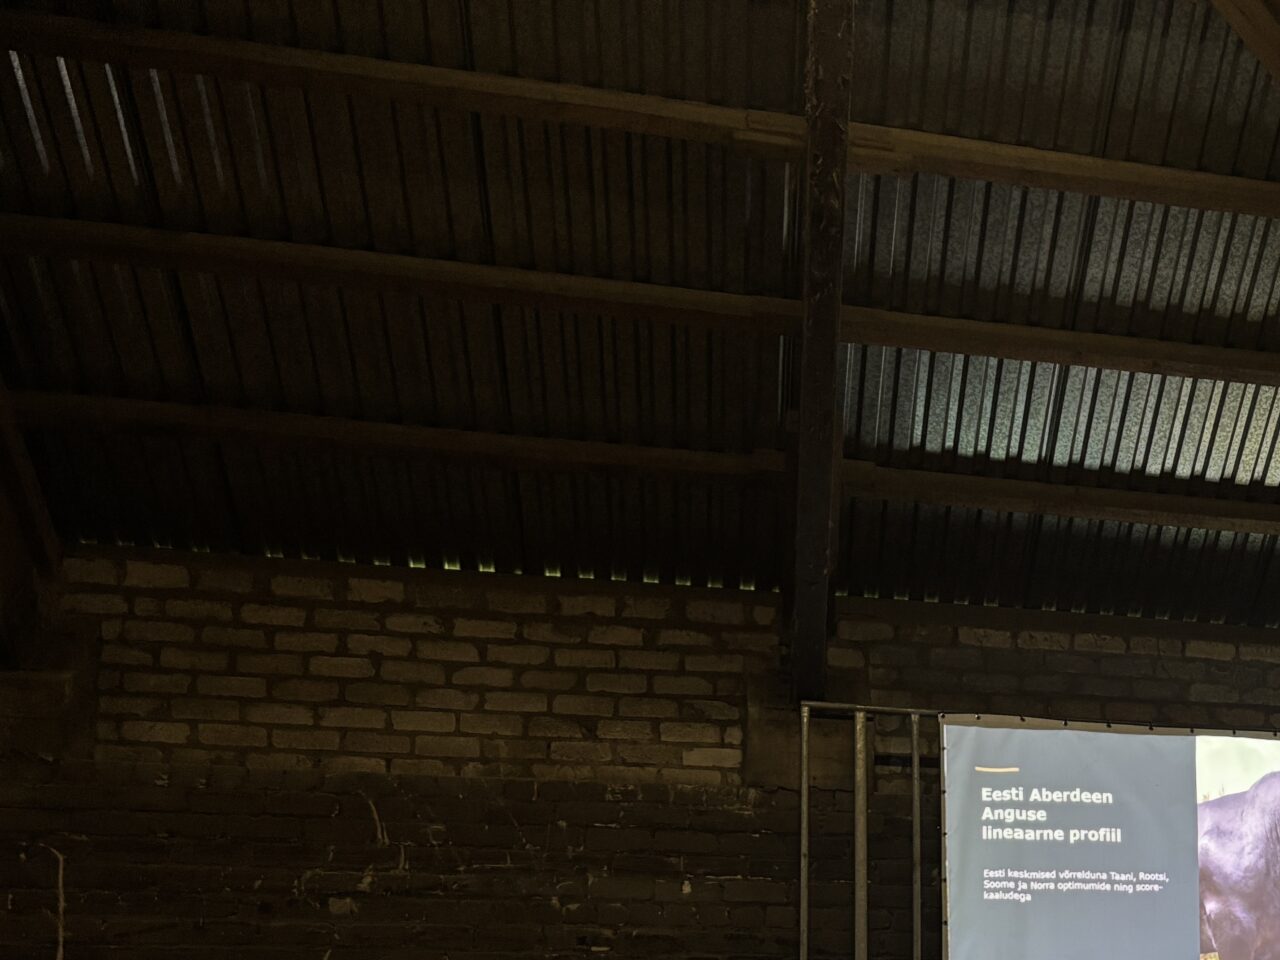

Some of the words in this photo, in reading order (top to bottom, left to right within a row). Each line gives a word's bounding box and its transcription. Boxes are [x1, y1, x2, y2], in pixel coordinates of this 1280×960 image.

[981, 787, 1024, 802] Eesti
[1029, 788, 1113, 804] Aberdeen
[981, 807, 1047, 823] Anguse
[982, 826, 1065, 841] lineaarne
[1069, 828, 1122, 844] profiil
[983, 869, 1006, 879] Eesti
[1007, 869, 1056, 880] keskmised
[1109, 871, 1137, 882] Taani,
[1139, 872, 1170, 883] Rootsi,
[983, 880, 1015, 889] Soome
[1016, 880, 1028, 891] ja
[1030, 881, 1055, 890] Norra
[1057, 882, 1111, 892] optimumide
[1113, 883, 1134, 894] ning
[1135, 883, 1164, 892] score-
[983, 892, 1032, 903] kaaludega
